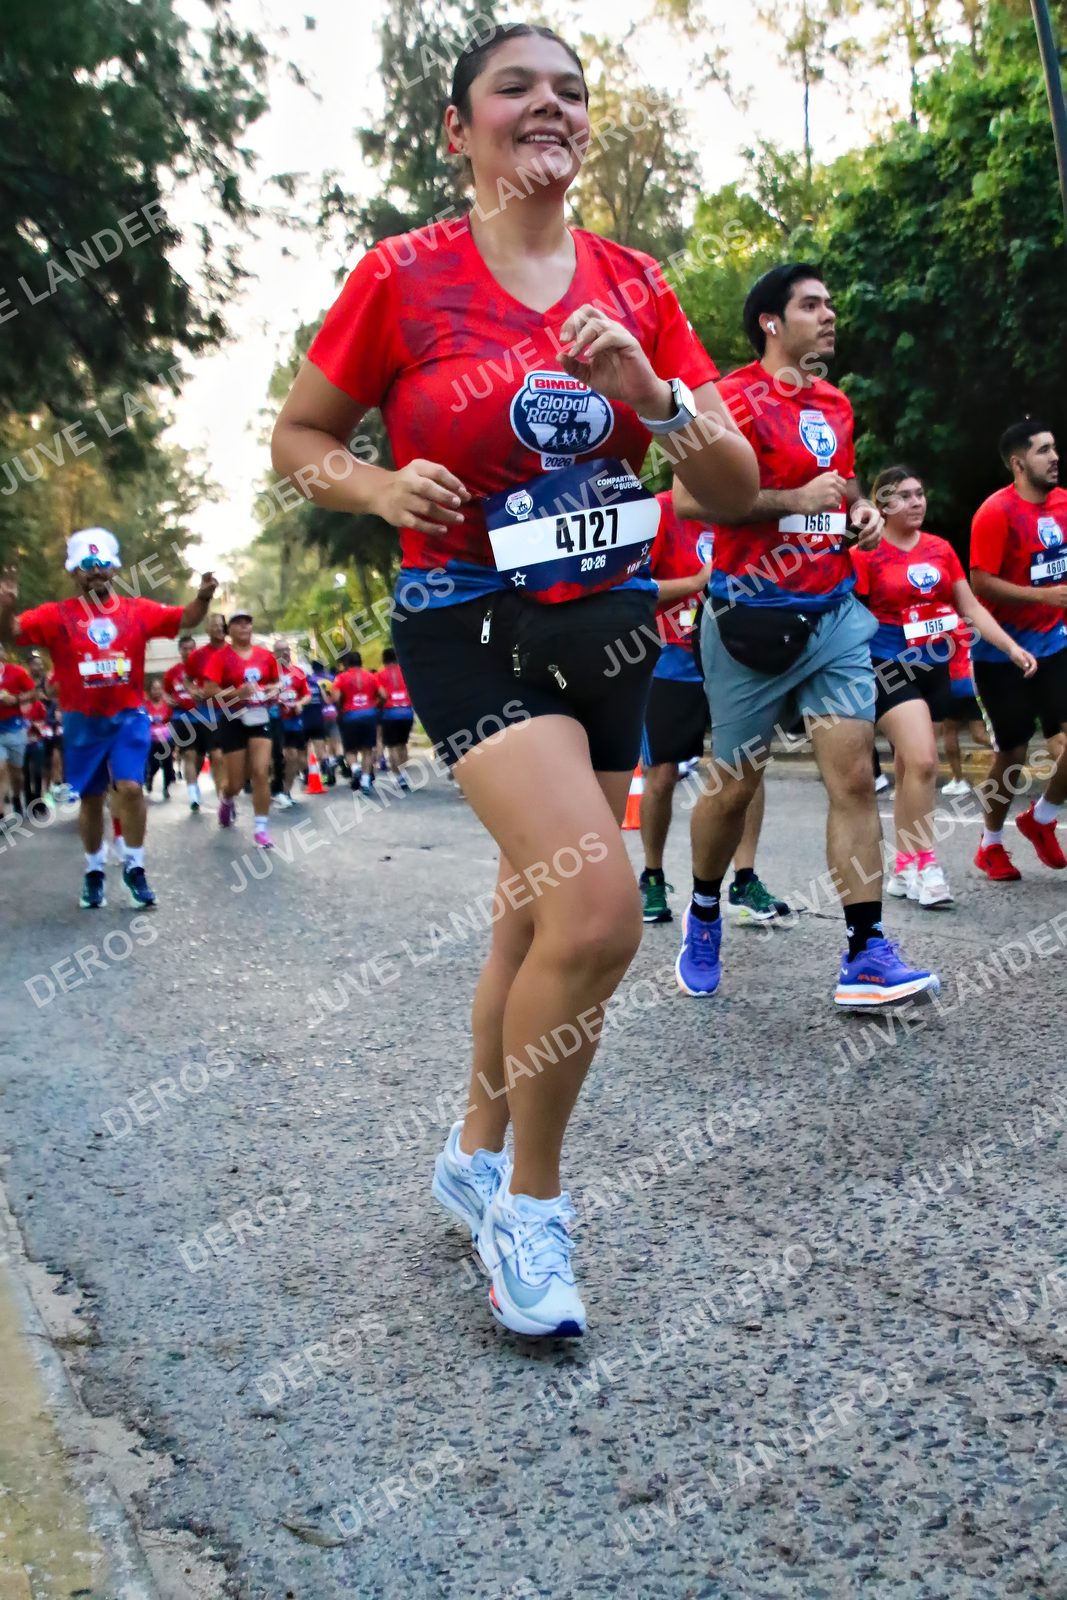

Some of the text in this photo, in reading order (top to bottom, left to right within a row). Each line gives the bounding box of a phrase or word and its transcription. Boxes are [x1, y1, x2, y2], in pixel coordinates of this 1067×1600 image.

[535, 379, 588, 391] BIMBO
[537, 395, 588, 412] Global
[526, 408, 569, 424] Race
[545, 457, 572, 467] 2026
[556, 508, 617, 553] 4727
[1046, 559, 1066, 574] 4600
[925, 619, 944, 634] 1515
